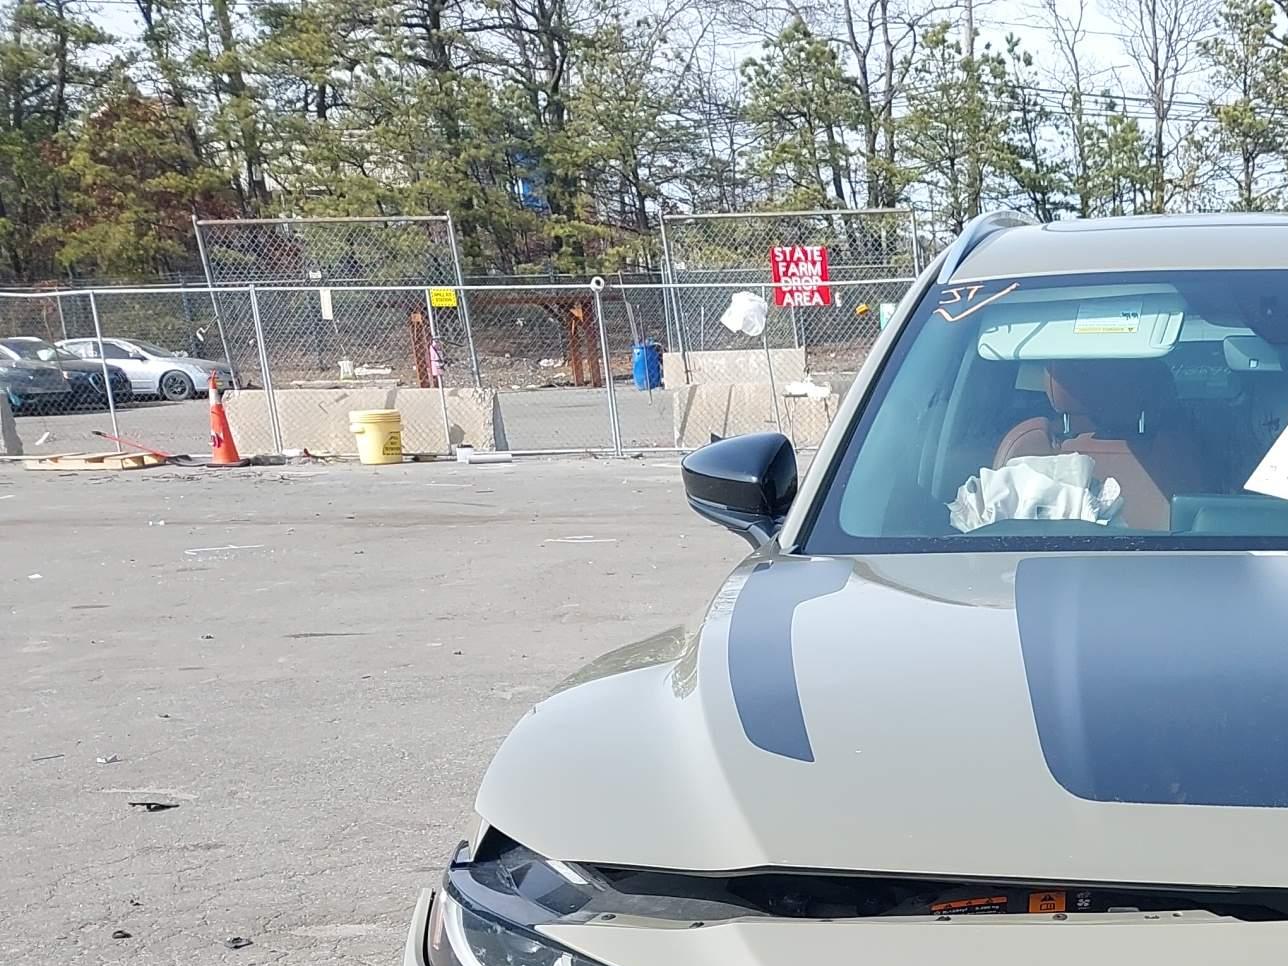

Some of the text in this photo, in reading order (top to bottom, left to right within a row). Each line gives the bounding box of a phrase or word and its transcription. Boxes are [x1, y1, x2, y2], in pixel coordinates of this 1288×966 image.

[774, 245, 823, 262] STATE
[778, 261, 823, 277] FARM
[781, 276, 821, 291] DROP
[783, 291, 825, 306] AREA
